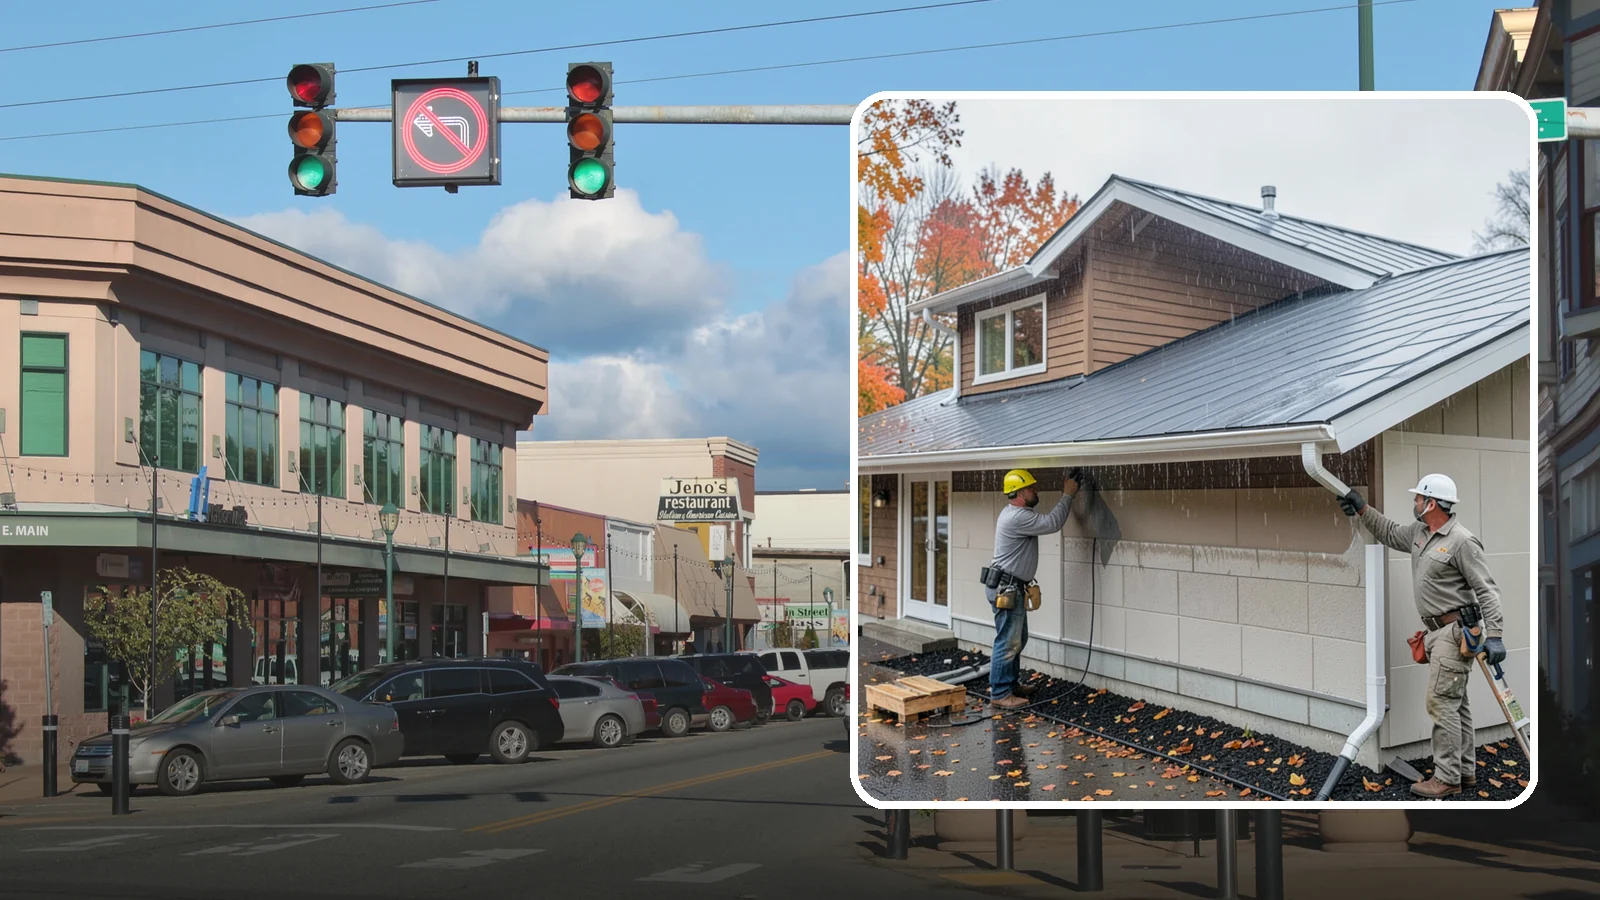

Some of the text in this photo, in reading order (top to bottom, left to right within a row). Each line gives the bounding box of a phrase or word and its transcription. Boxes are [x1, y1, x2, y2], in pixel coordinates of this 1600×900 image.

[669, 480, 728, 495] Jeno's
[665, 496, 731, 509] restaurant
[658, 510, 681, 519] Italian
[685, 510, 714, 519] American
[715, 510, 738, 519] Cuisine
[2, 525, 49, 536] E. MAIN
[797, 607, 828, 617] Street
